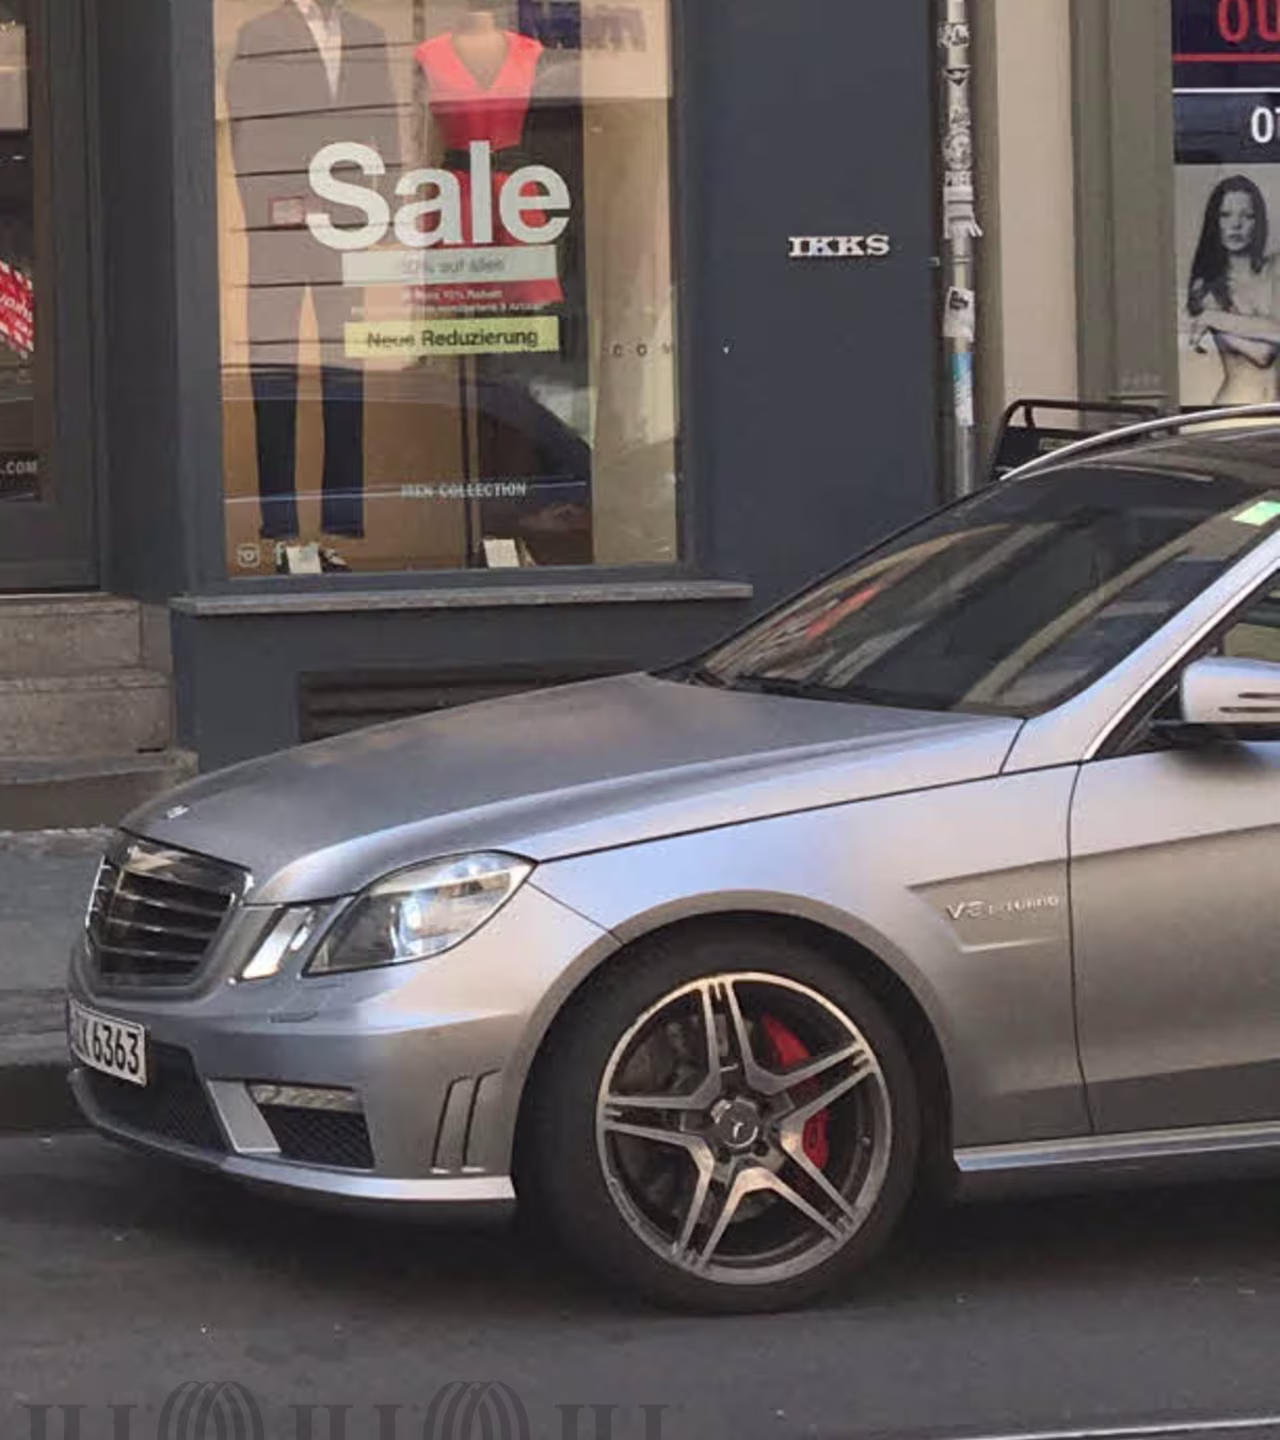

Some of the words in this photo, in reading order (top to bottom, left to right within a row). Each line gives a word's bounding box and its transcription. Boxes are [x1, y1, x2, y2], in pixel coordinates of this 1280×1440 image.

[305, 140, 571, 250] Sale
[788, 234, 890, 257] IKKS
[367, 331, 415, 348] Neue
[421, 328, 539, 347] Reduzierung
[440, 481, 527, 498] COLLECTION
[93, 1020, 140, 1075] 6363
